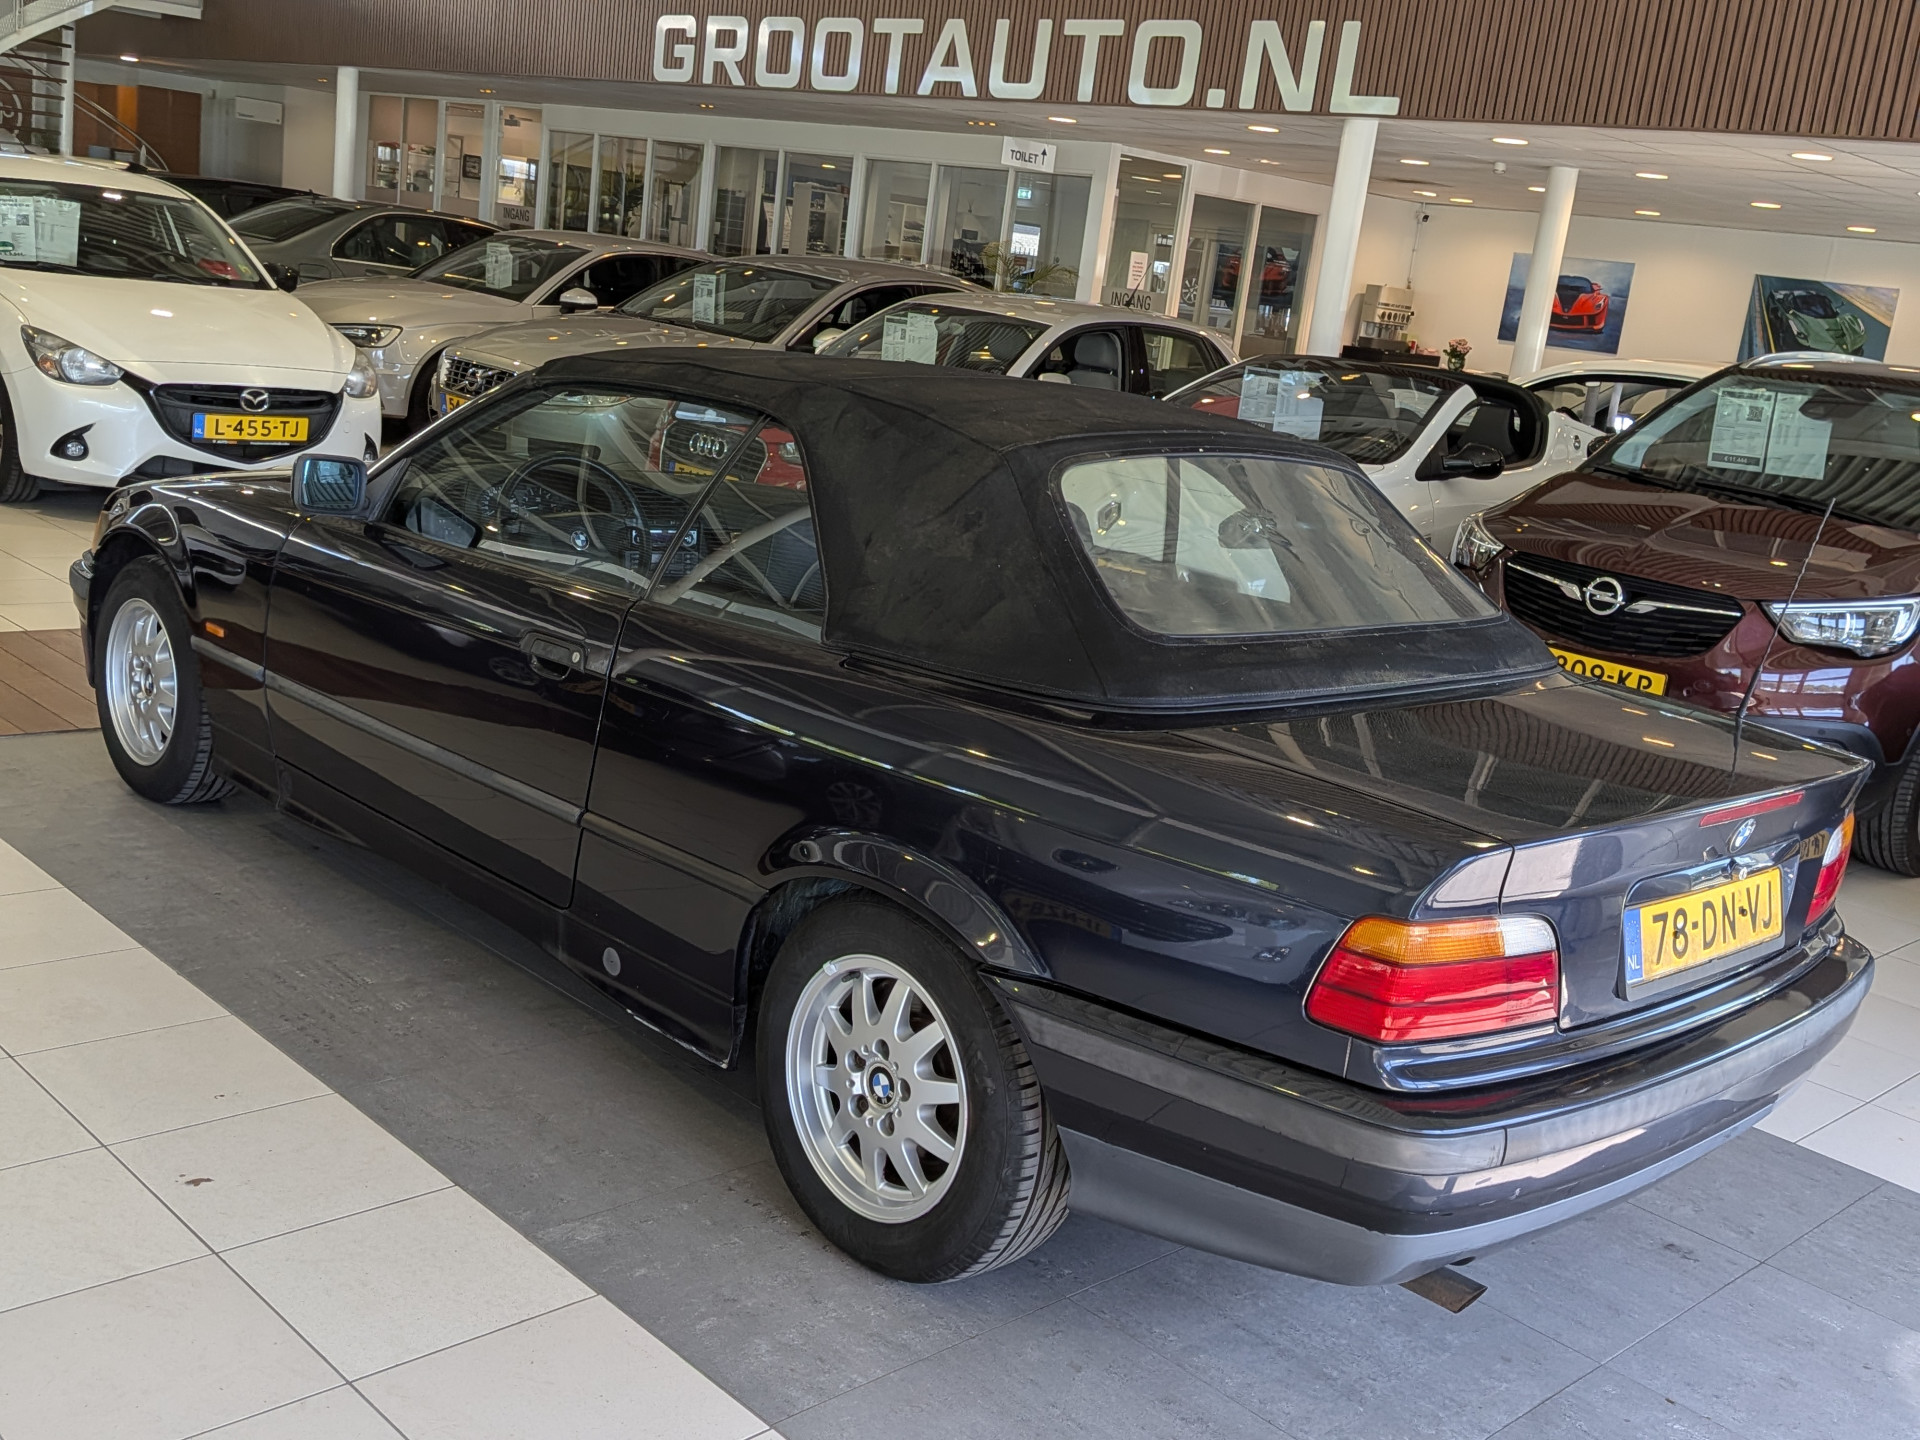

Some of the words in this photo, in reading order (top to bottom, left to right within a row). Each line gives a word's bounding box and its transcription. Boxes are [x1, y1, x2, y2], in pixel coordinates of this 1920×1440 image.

[653, 14, 1400, 116] GROOTAUTO.NL
[1010, 149, 1039, 165] TOILET
[503, 207, 530, 222] INGANG
[1111, 291, 1152, 311] INGANG
[214, 418, 300, 438] L-455-TJ
[1652, 880, 1772, 966] 78-DN-VJ
[1627, 953, 1641, 970] NL
